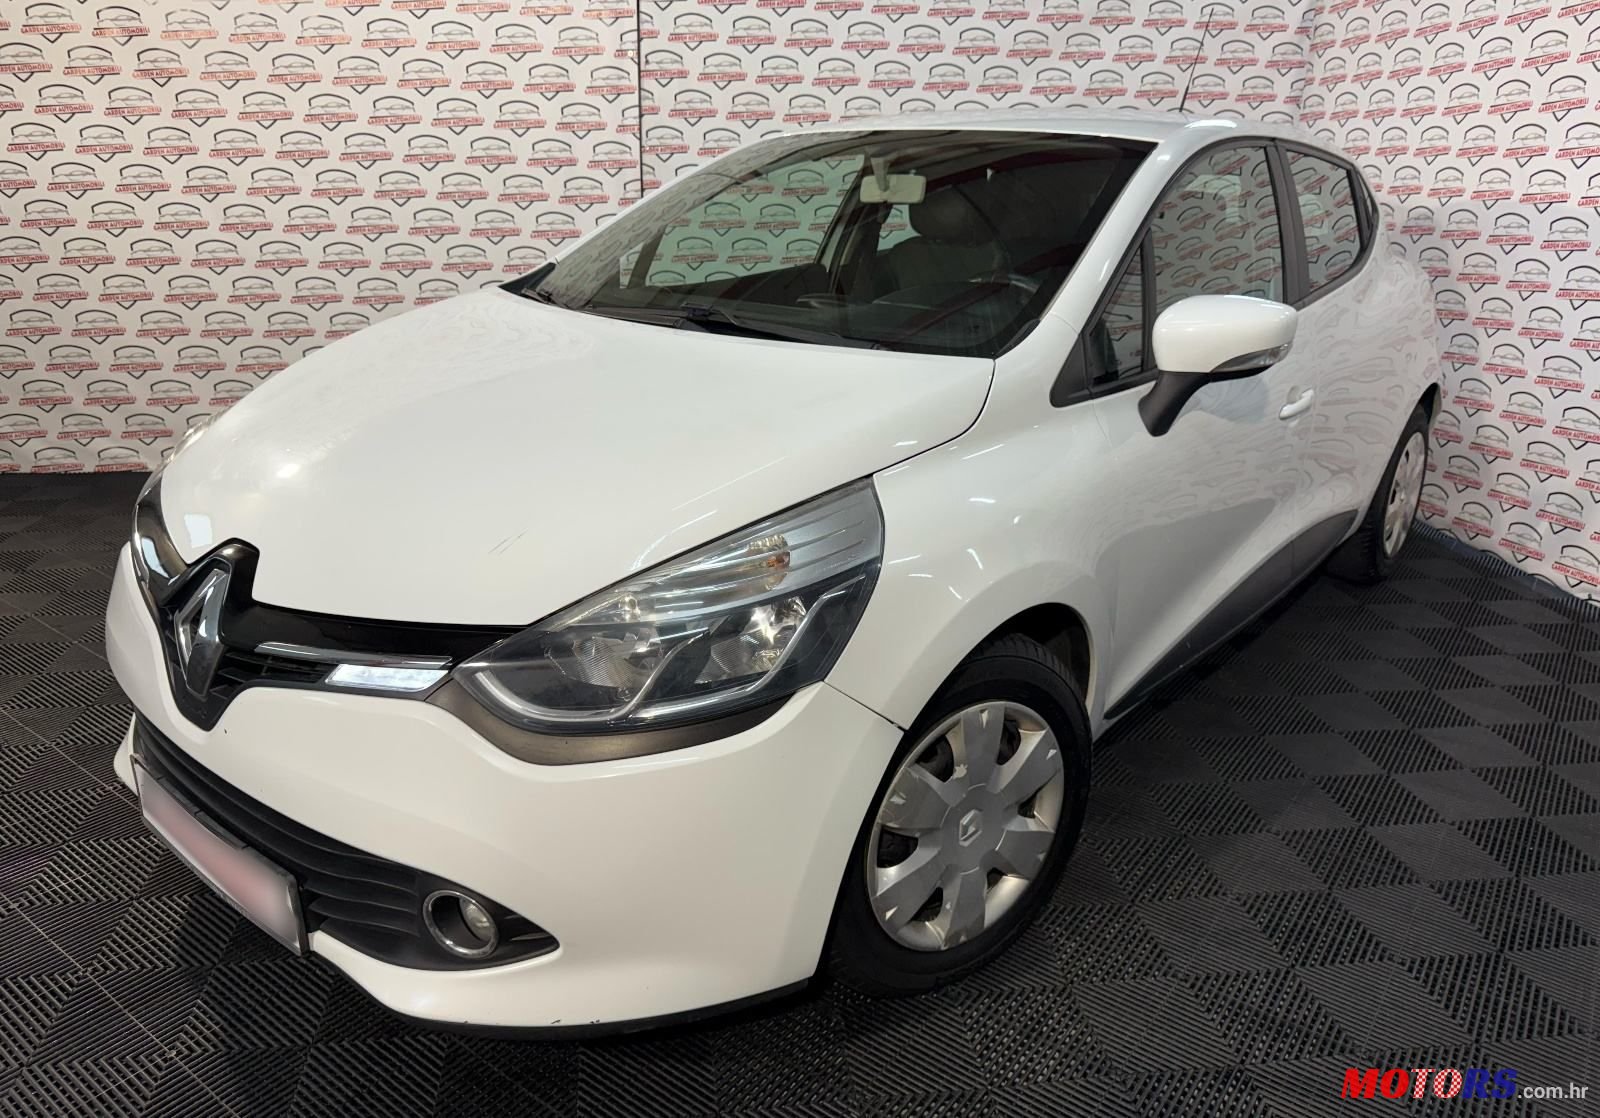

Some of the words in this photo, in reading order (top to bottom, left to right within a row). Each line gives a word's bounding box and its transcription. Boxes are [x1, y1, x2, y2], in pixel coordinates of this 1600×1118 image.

[45, 23, 82, 31] AUTOMOBILI
[688, 31, 719, 40] AUTOMOBILI
[804, 37, 833, 45] AUTOMOBILI
[1540, 50, 1571, 63] AUTOMOBILI
[86, 65, 122, 73] AUTOMOBILI
[155, 67, 189, 76] AUTOMOBILI
[289, 73, 323, 81] AUTOMOBILI
[717, 71, 747, 79] AUTOMOBILI
[775, 74, 804, 82] AUTOMOBILI
[418, 77, 451, 85] AUTOMOBILI
[544, 82, 576, 90] AUTOMOBILI
[1557, 96, 1589, 109] AUTOMOBILI
[58, 103, 93, 111] AUTOMOBILI
[127, 106, 162, 114] AUTOMOBILI
[193, 108, 227, 116] AUTOMOBILI
[260, 110, 294, 118] AUTOMOBILI
[688, 107, 718, 116] AUTOMOBILI
[325, 112, 358, 120] AUTOMOBILI
[452, 116, 485, 124] AUTOMOBILI
[30, 141, 65, 149] AUTOMOBILI
[98, 143, 134, 151] AUTOMOBILI
[165, 145, 200, 153] AUTOMOBILI
[231, 147, 266, 155] AUTOMOBILI
[297, 149, 330, 157] AUTOMOBILI
[361, 151, 393, 159] AUTOMOBILI
[70, 180, 105, 189] AUTOMOBILI
[137, 182, 171, 190] AUTOMOBILI
[203, 184, 237, 192] AUTOMOBILI
[268, 185, 302, 193] AUTOMOBILI
[457, 190, 489, 198] AUTOMOBILI
[1538, 192, 1571, 201] AUTOMOBILI
[42, 217, 77, 225] AUTOMOBILI
[109, 218, 144, 227] AUTOMOBILI
[176, 220, 209, 228] AUTOMOBILI
[240, 221, 273, 229] AUTOMOBILI
[304, 222, 337, 230] AUTOMOBILI
[429, 225, 461, 233] AUTOMOBILI
[1559, 240, 1591, 248] AUTOMOBILI
[82, 255, 116, 263] AUTOMOBILI
[148, 256, 181, 264] AUTOMOBILI
[55, 290, 89, 299] AUTOMOBILI
[120, 291, 154, 299] AUTOMOBILI
[185, 292, 218, 300] AUTOMOBILI
[28, 326, 62, 334] AUTOMOBILI
[93, 326, 126, 334] AUTOMOBILI
[158, 327, 191, 335] AUTOMOBILI
[67, 361, 100, 369] AUTOMOBILI
[130, 361, 163, 370] AUTOMOBILI
[1553, 380, 1585, 389] AUTOMOBILI
[104, 395, 137, 403] AUTOMOBILI
[1539, 465, 1570, 476] AUTOMOBILI
